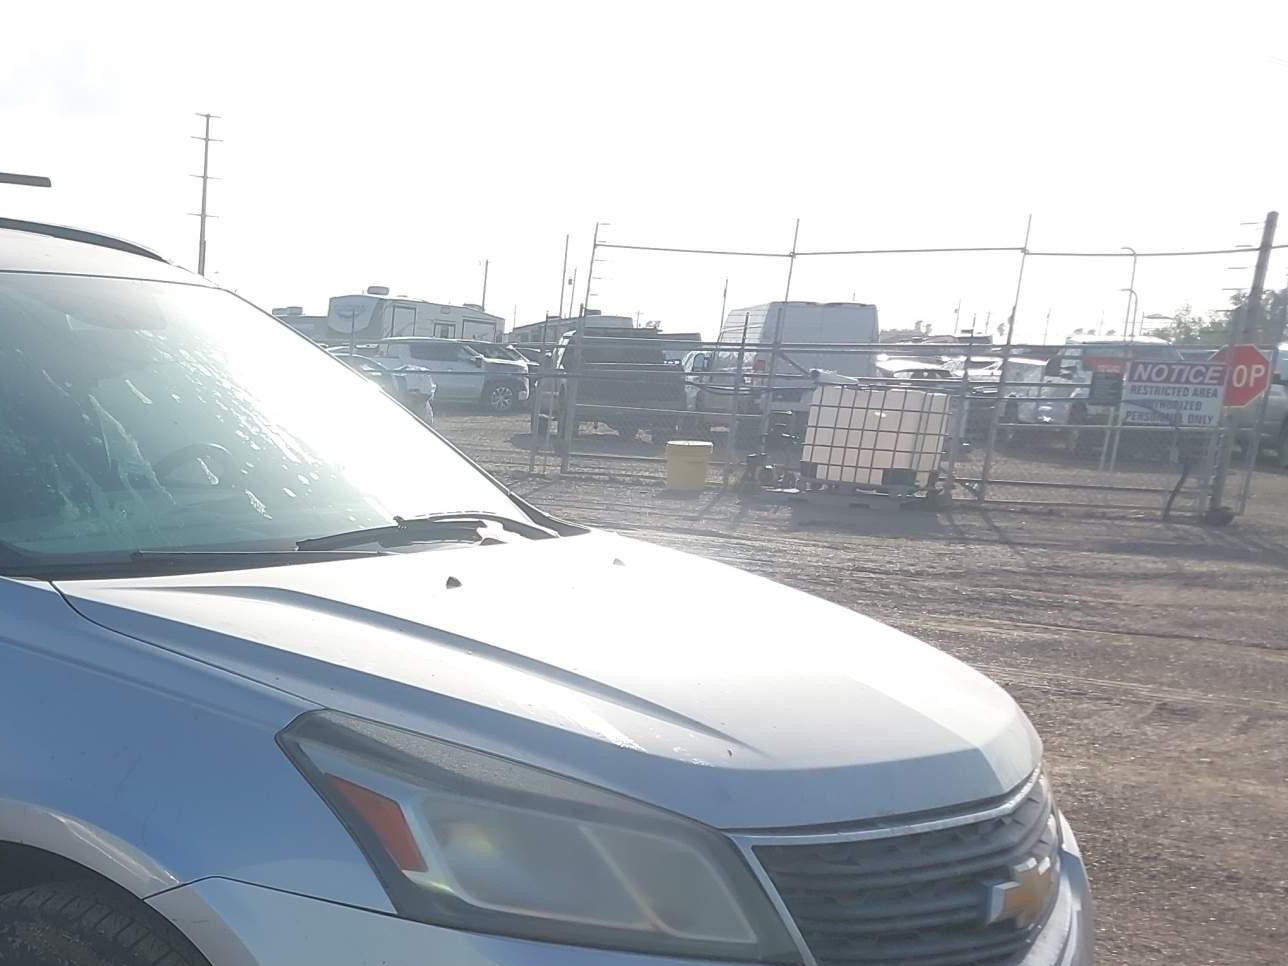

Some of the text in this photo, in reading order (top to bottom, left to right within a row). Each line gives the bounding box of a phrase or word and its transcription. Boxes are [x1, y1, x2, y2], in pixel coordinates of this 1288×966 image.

[1133, 364, 1224, 384] NOTICE
[1232, 364, 1265, 388] OP
[1130, 385, 1219, 399] RESTRICTED AREA
[1144, 398, 1202, 411] THOIZED
[1126, 411, 1215, 425] PERSOL ONLY
